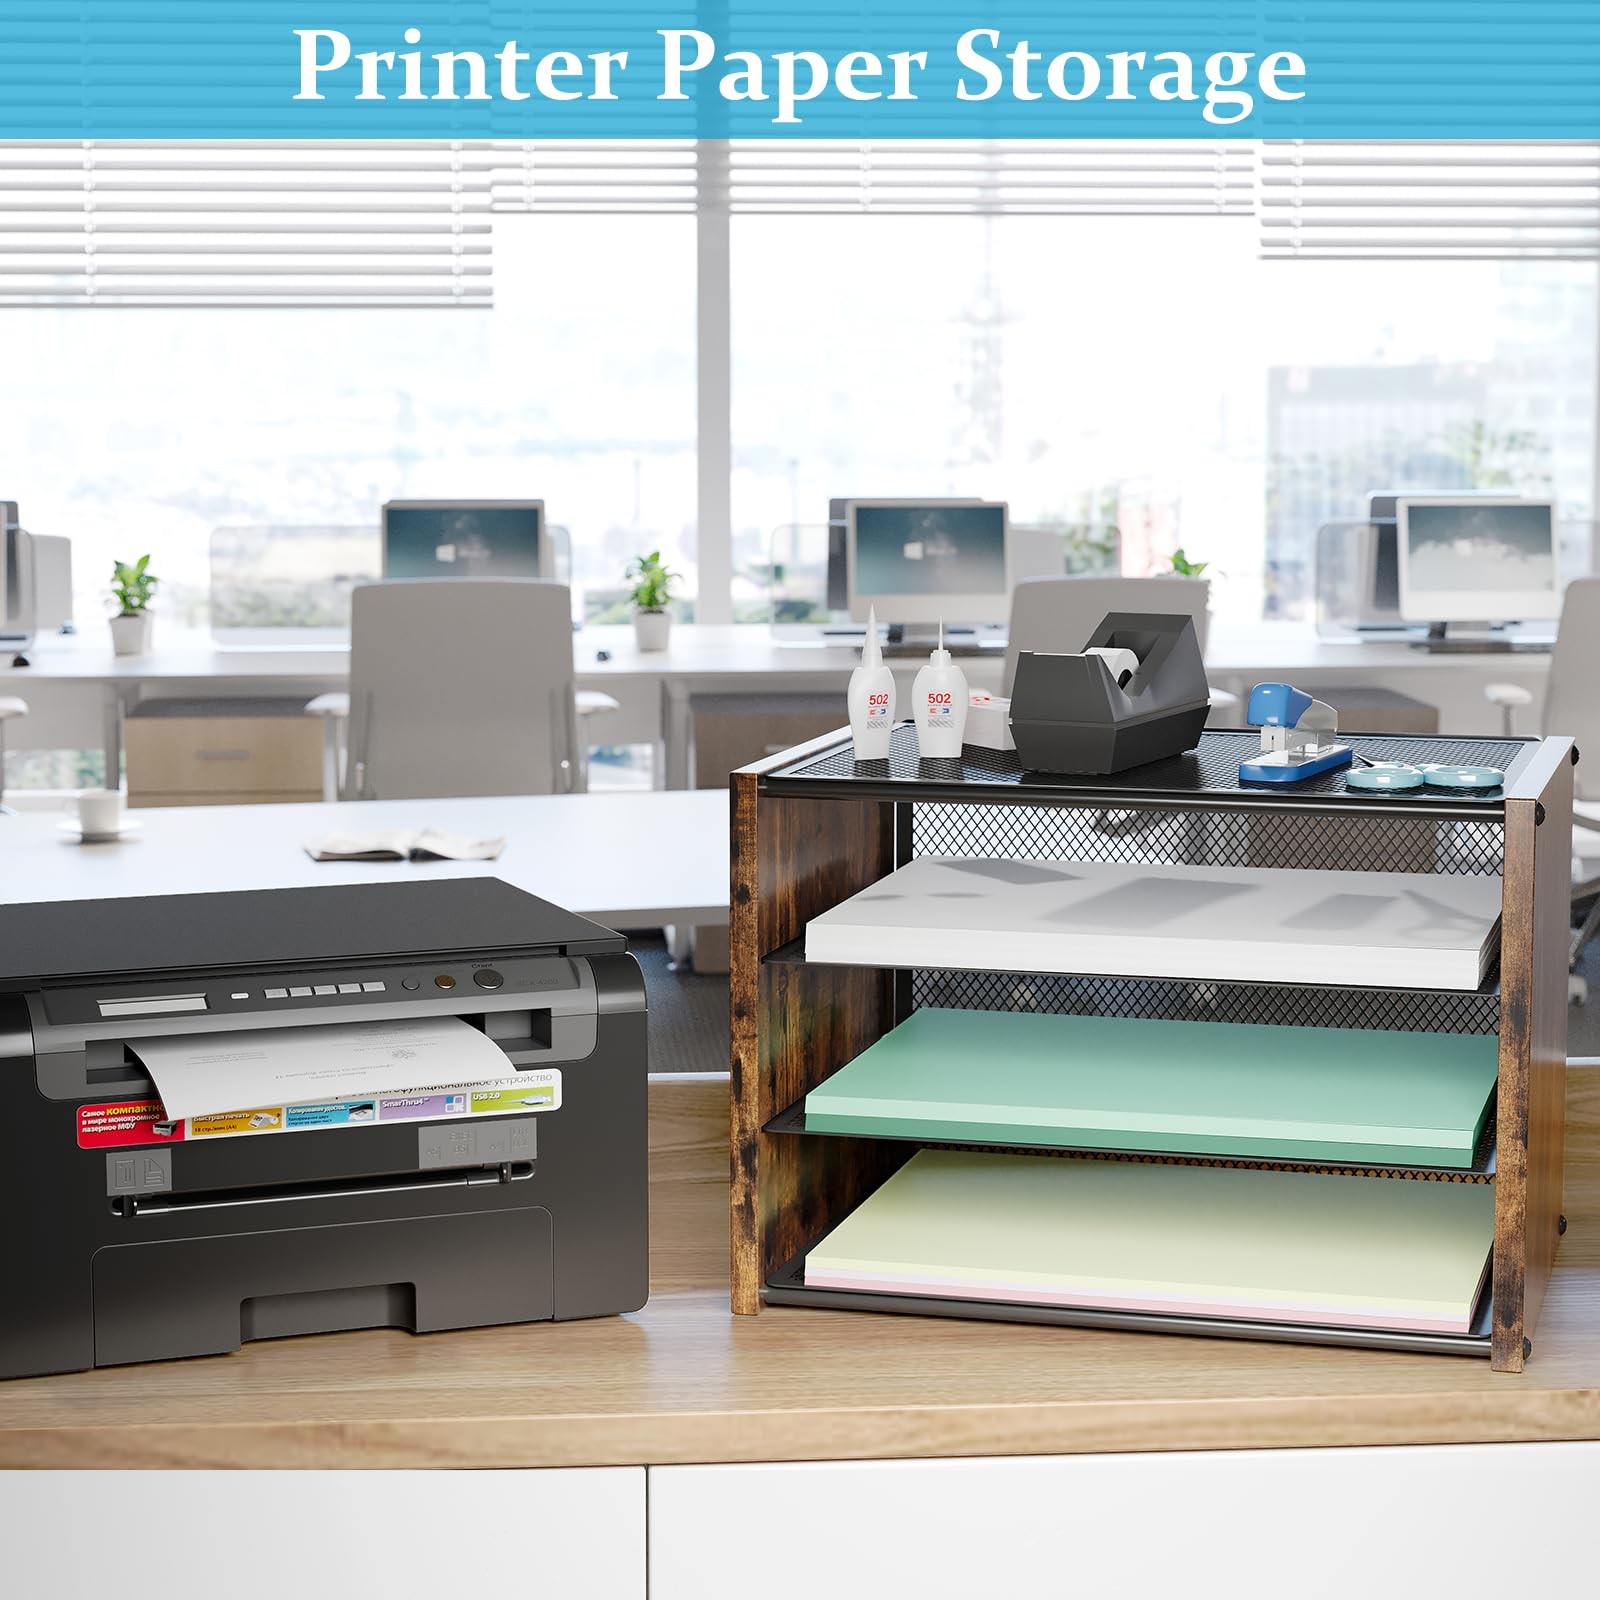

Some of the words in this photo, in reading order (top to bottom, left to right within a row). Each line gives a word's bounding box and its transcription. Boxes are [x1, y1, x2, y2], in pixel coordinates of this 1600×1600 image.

[869, 694, 888, 705] 502
[928, 693, 951, 704] 502
[489, 1091, 500, 1099] 2.0
[81, 1110, 105, 1118] Самое
[88, 1117, 107, 1125] мире
[81, 1125, 117, 1133] лазерное
[117, 1122, 136, 1130] МФУ
